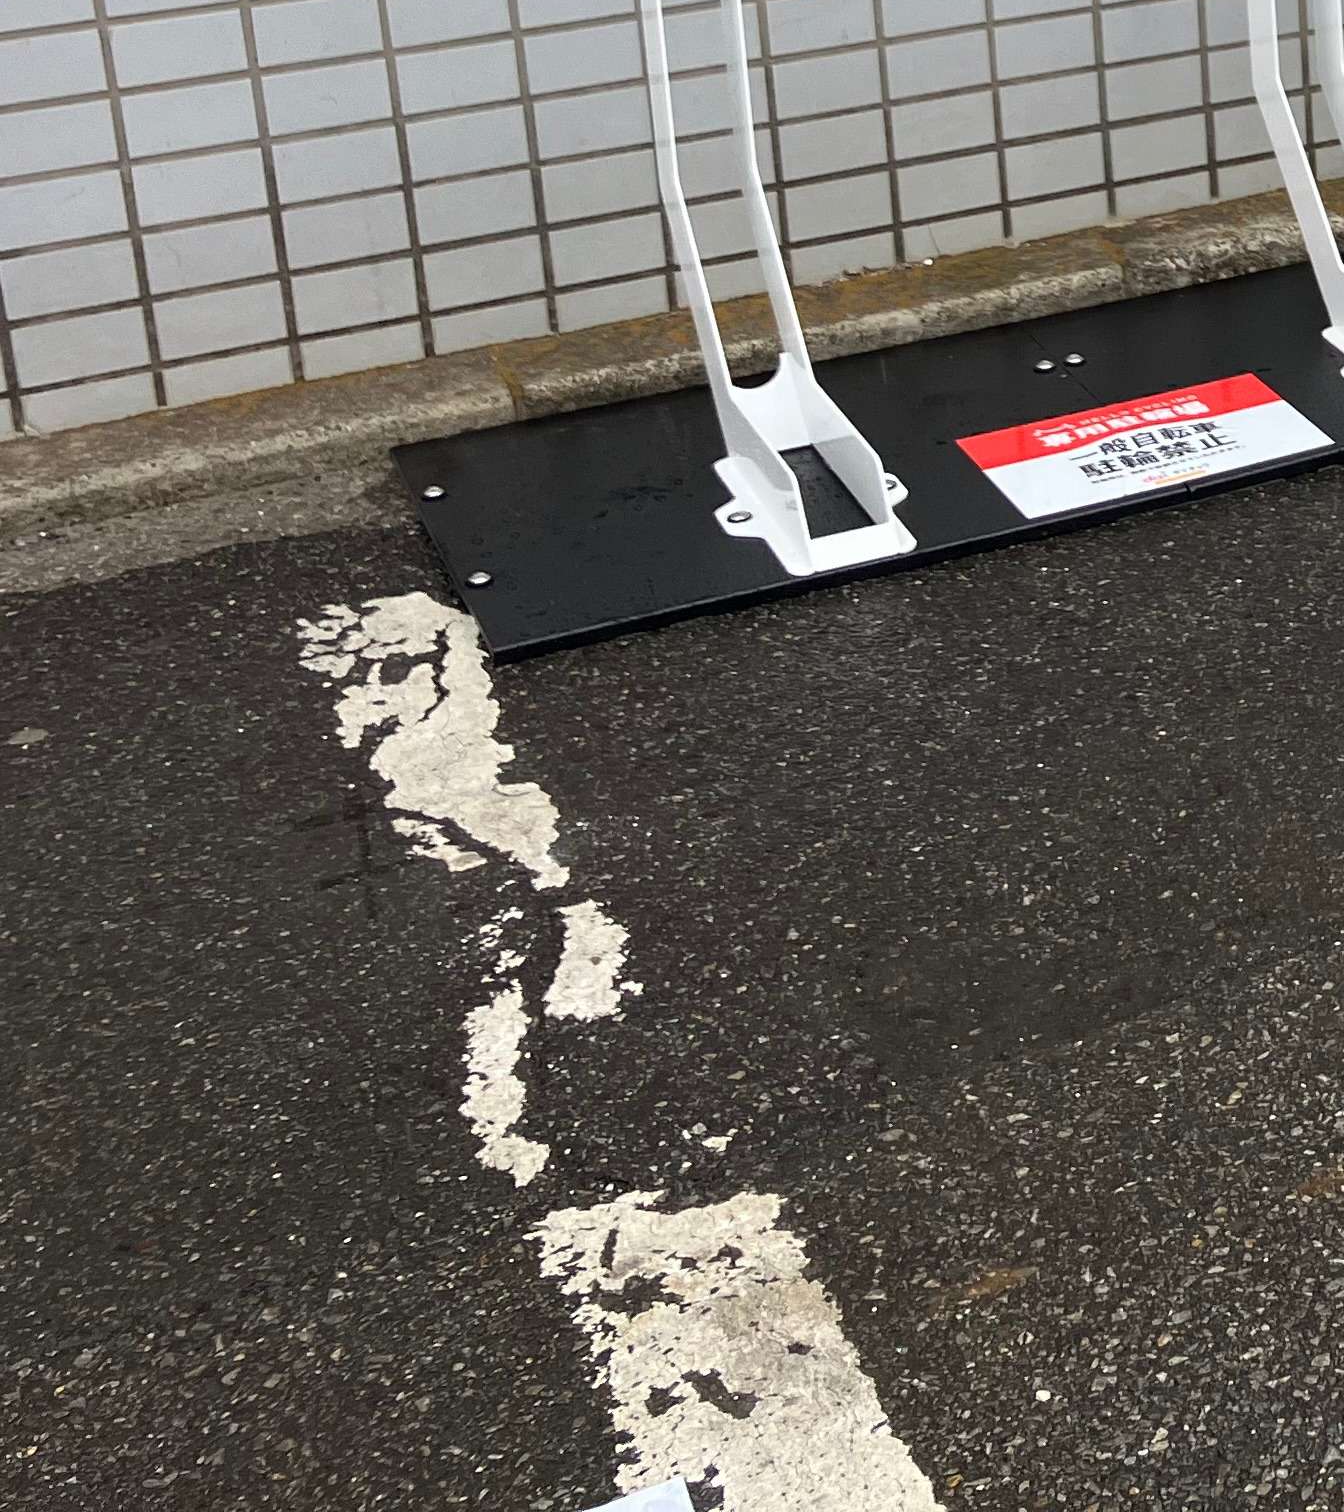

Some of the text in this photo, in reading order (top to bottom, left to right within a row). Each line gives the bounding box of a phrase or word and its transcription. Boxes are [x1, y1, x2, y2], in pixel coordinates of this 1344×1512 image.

[1069, 421, 1222, 461] 一般自転車
[1078, 433, 1238, 479] 駐輪禁止
